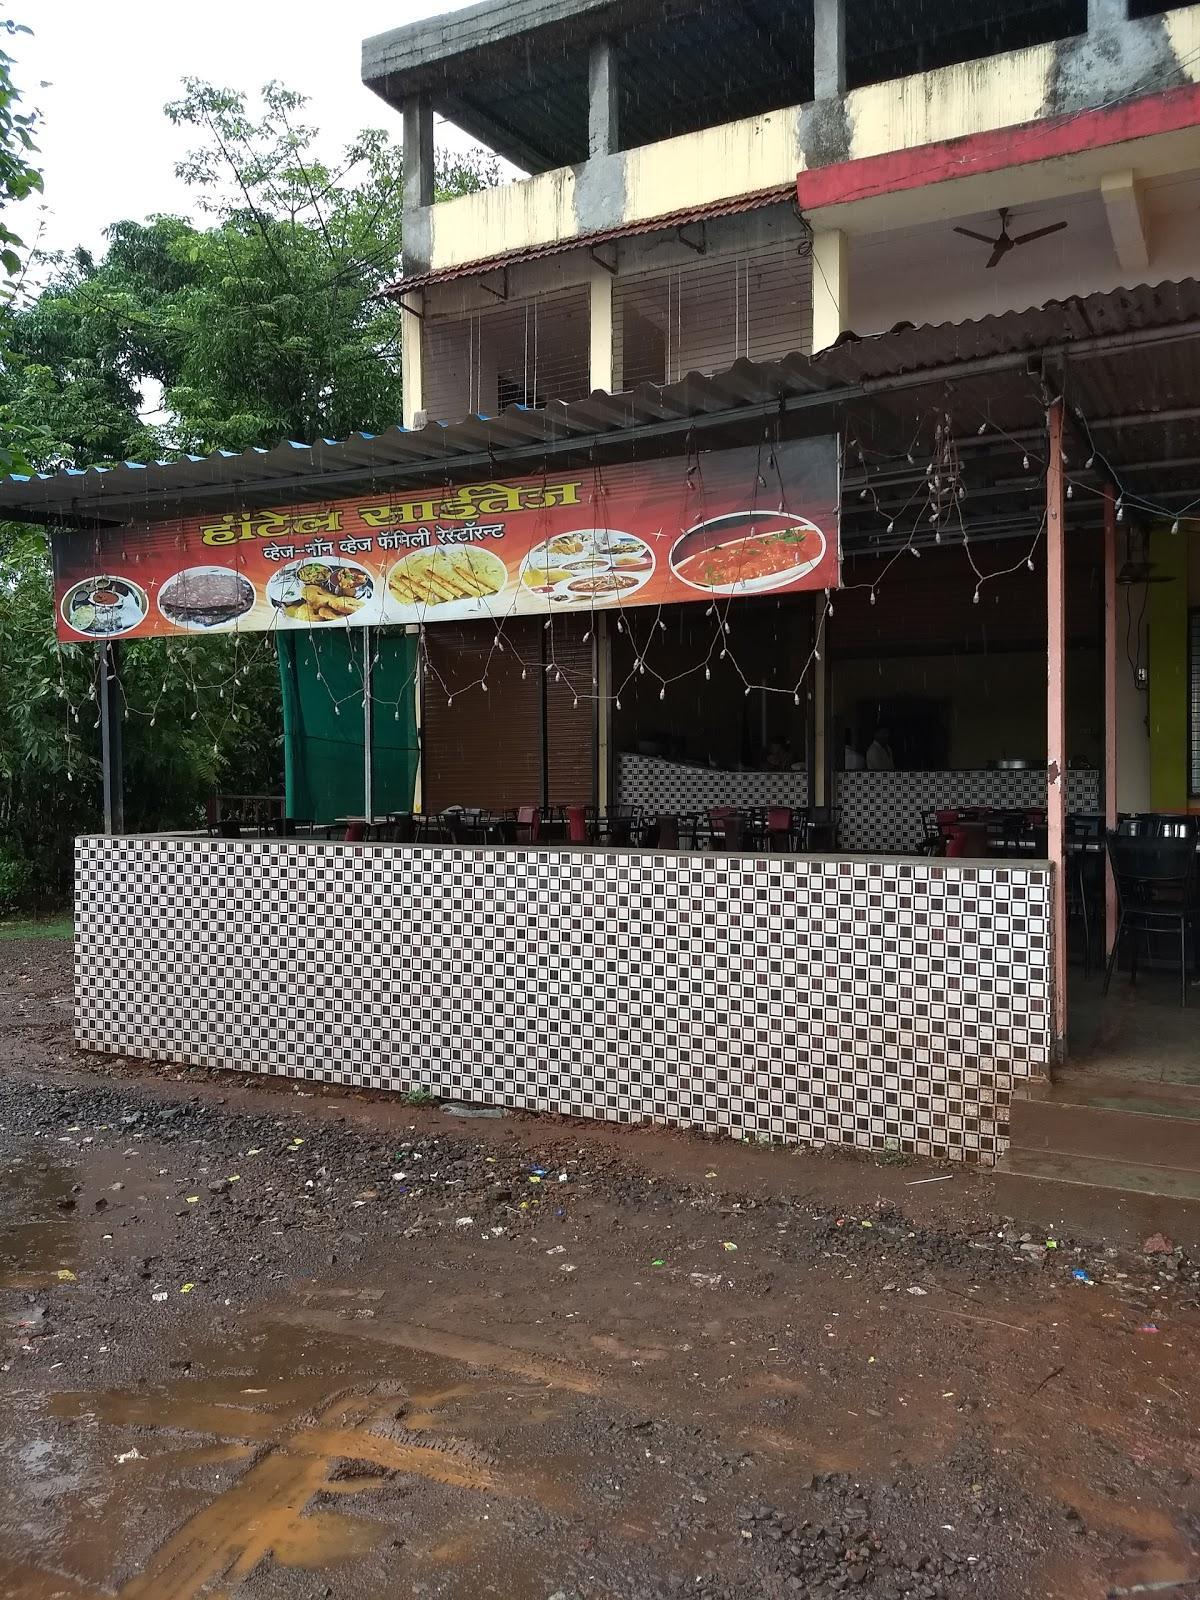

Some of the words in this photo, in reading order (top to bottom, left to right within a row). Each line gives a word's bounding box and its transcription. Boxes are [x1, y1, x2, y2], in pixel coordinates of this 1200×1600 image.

[339, 534, 372, 554] व्हेज
[377, 528, 430, 550] फॅमिली
[436, 522, 504, 545] रेस्टॉरन्ट
